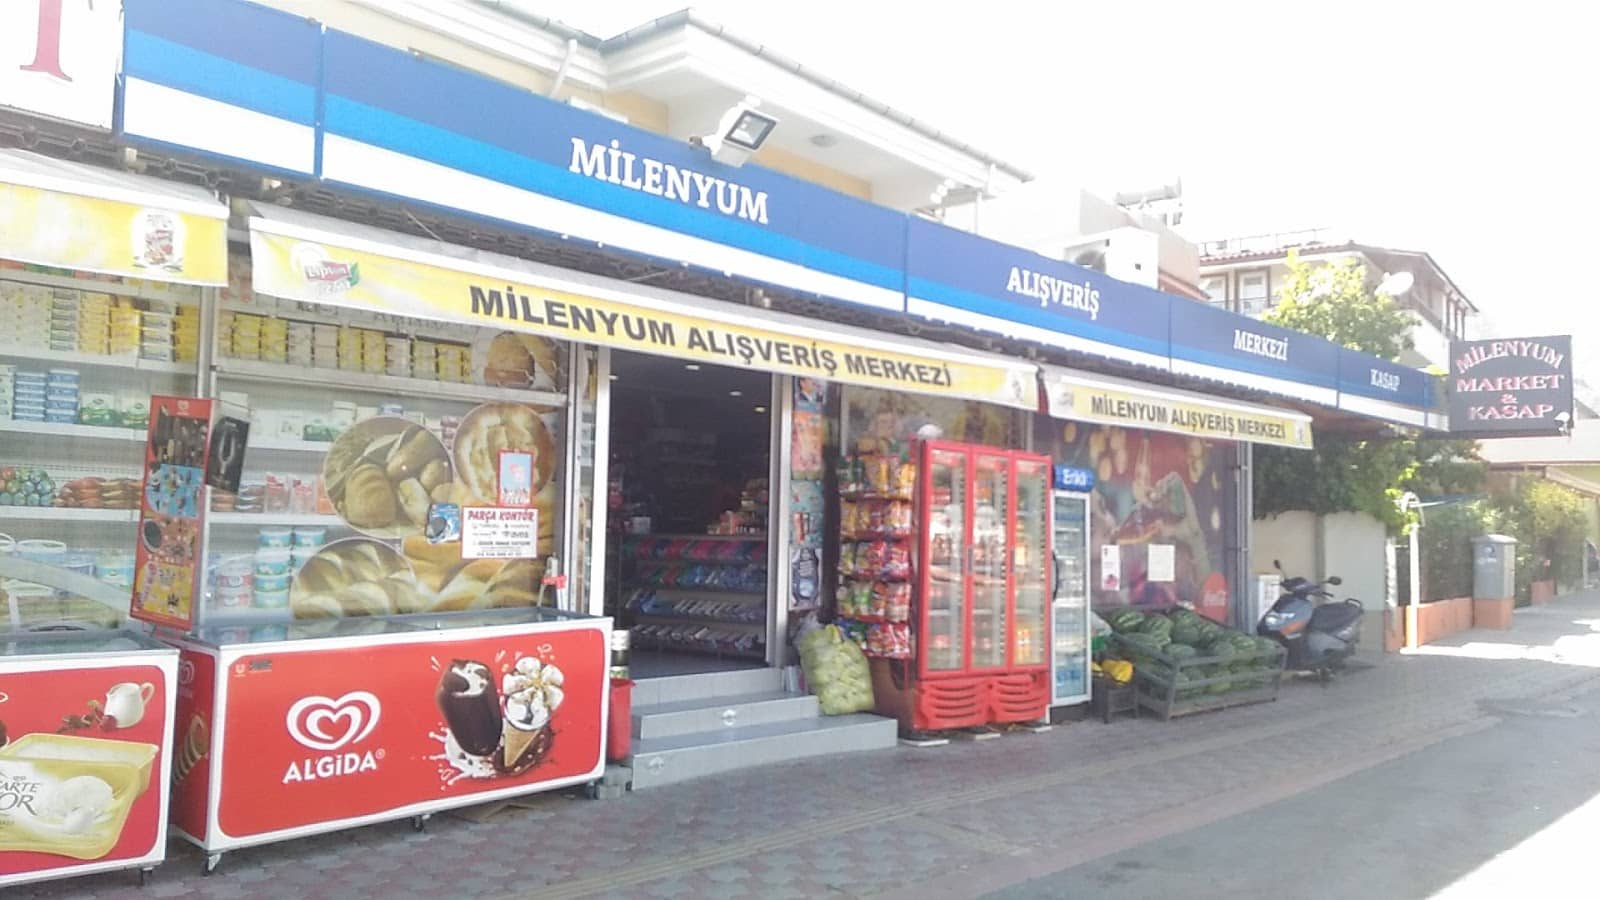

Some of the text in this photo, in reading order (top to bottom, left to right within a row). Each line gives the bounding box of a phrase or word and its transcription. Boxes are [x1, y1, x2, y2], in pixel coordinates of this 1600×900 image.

[568, 137, 1400, 392] MİLENYUM ALIŞVERİŞ MERKEZİ KASAP
[469, 285, 675, 346] MİLENYUM
[687, 327, 838, 376] ALIŞVERİŞ
[845, 354, 952, 387] MERKEZİ
[1456, 340, 1565, 374] MİLENYUM
[1455, 374, 1565, 392] MARKET
[1092, 395, 1168, 425] MİLENYUM
[1171, 409, 1235, 433] ALIŞVERİŞ
[1238, 418, 1285, 439] MERKEZİ
[1468, 404, 1554, 421] KASAP
[467, 510, 496, 523] PARÇA
[0, 781, 41, 795] ARTE
